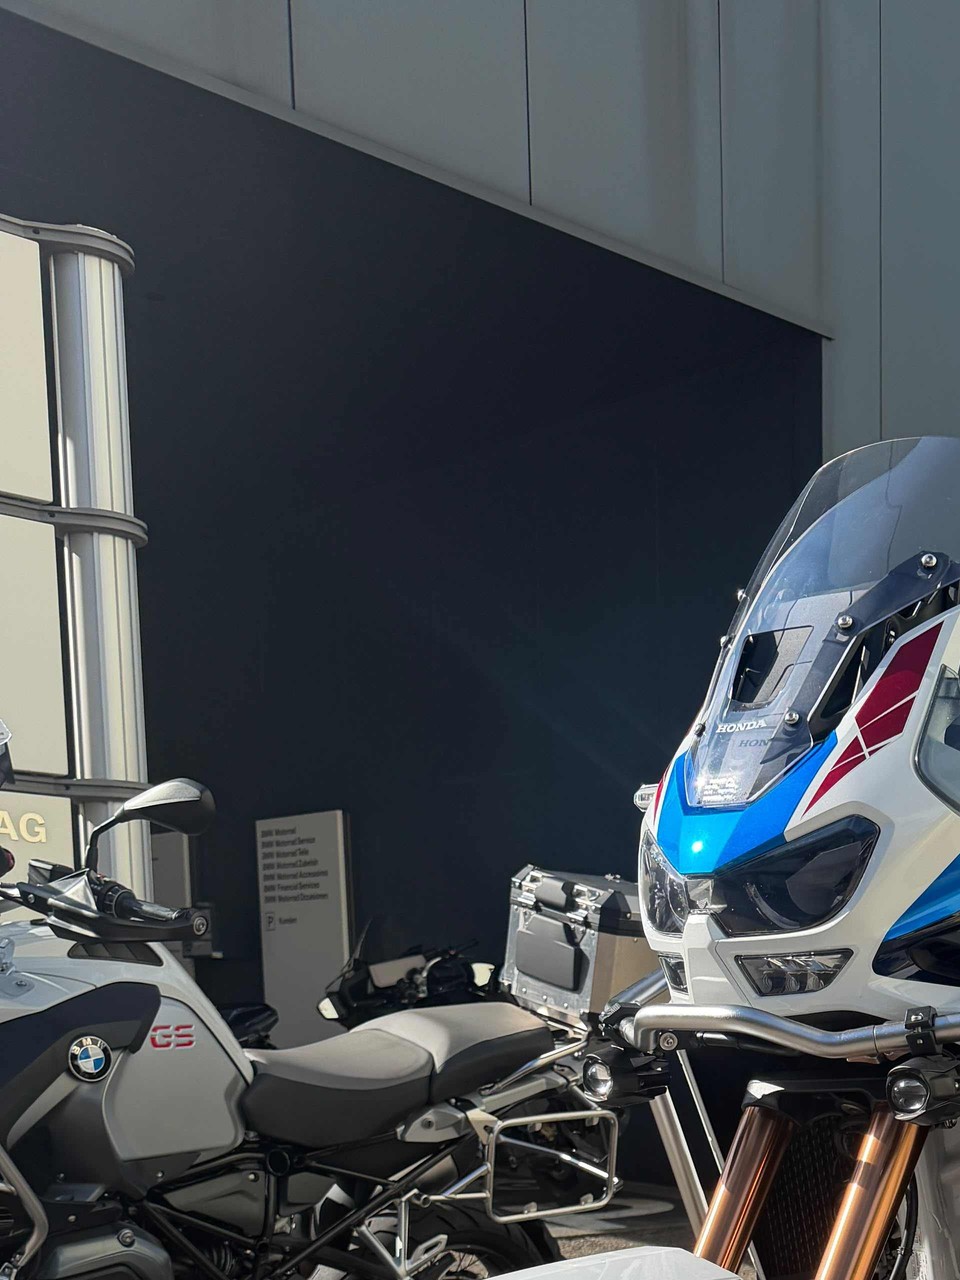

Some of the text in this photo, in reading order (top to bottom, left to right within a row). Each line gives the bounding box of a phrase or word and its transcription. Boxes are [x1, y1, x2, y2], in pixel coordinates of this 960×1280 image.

[716, 719, 767, 733] HONDA
[0, 810, 47, 843] AG
[150, 1024, 196, 1049] GS
